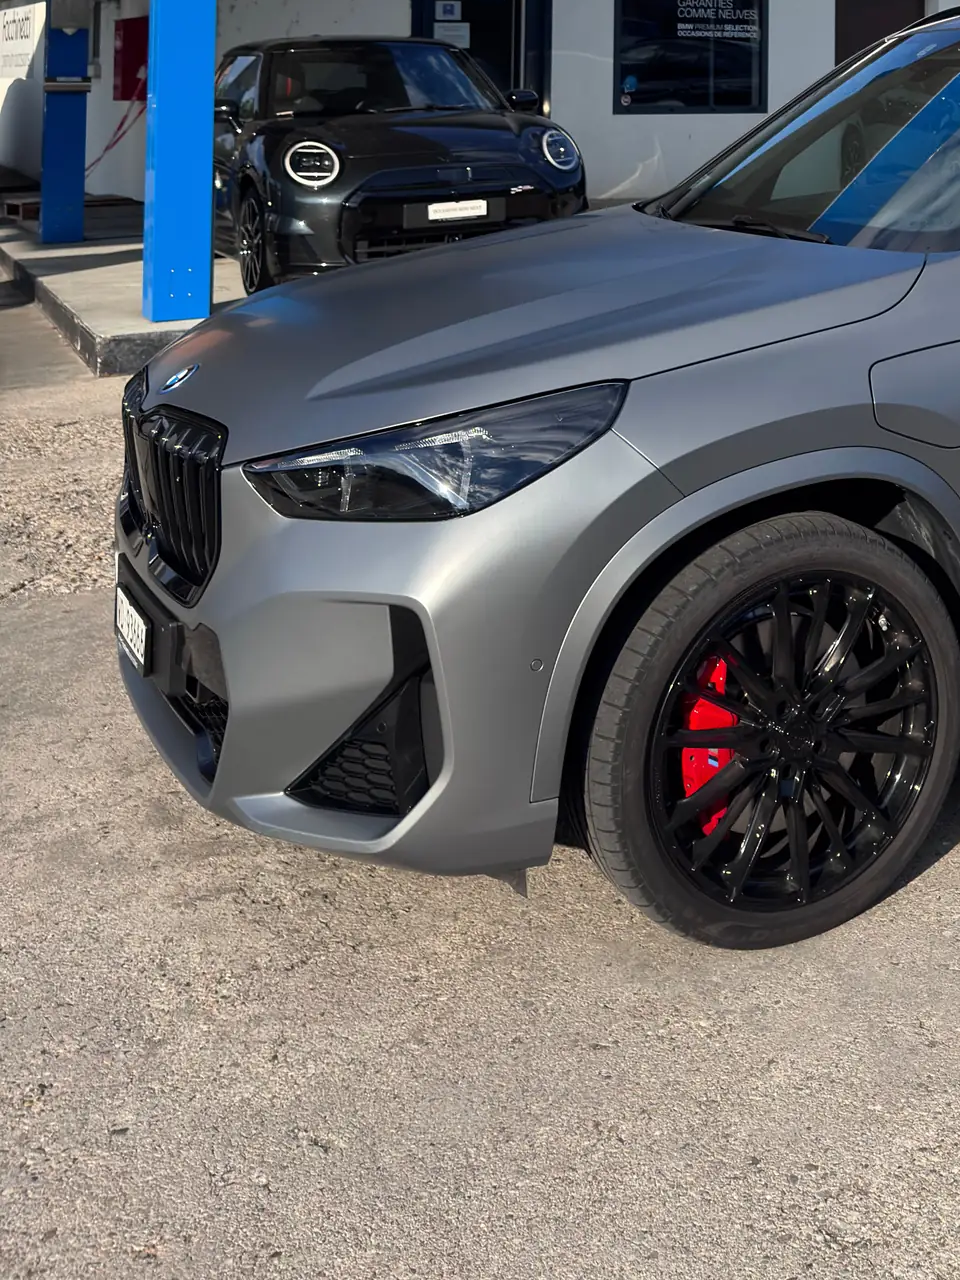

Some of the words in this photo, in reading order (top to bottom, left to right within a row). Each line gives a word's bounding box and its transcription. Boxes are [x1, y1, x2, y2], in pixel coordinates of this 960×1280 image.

[677, 7, 717, 19] COMME
[694, 23, 724, 31] PREMIUM
[677, 30, 714, 38] OCCASIONS
